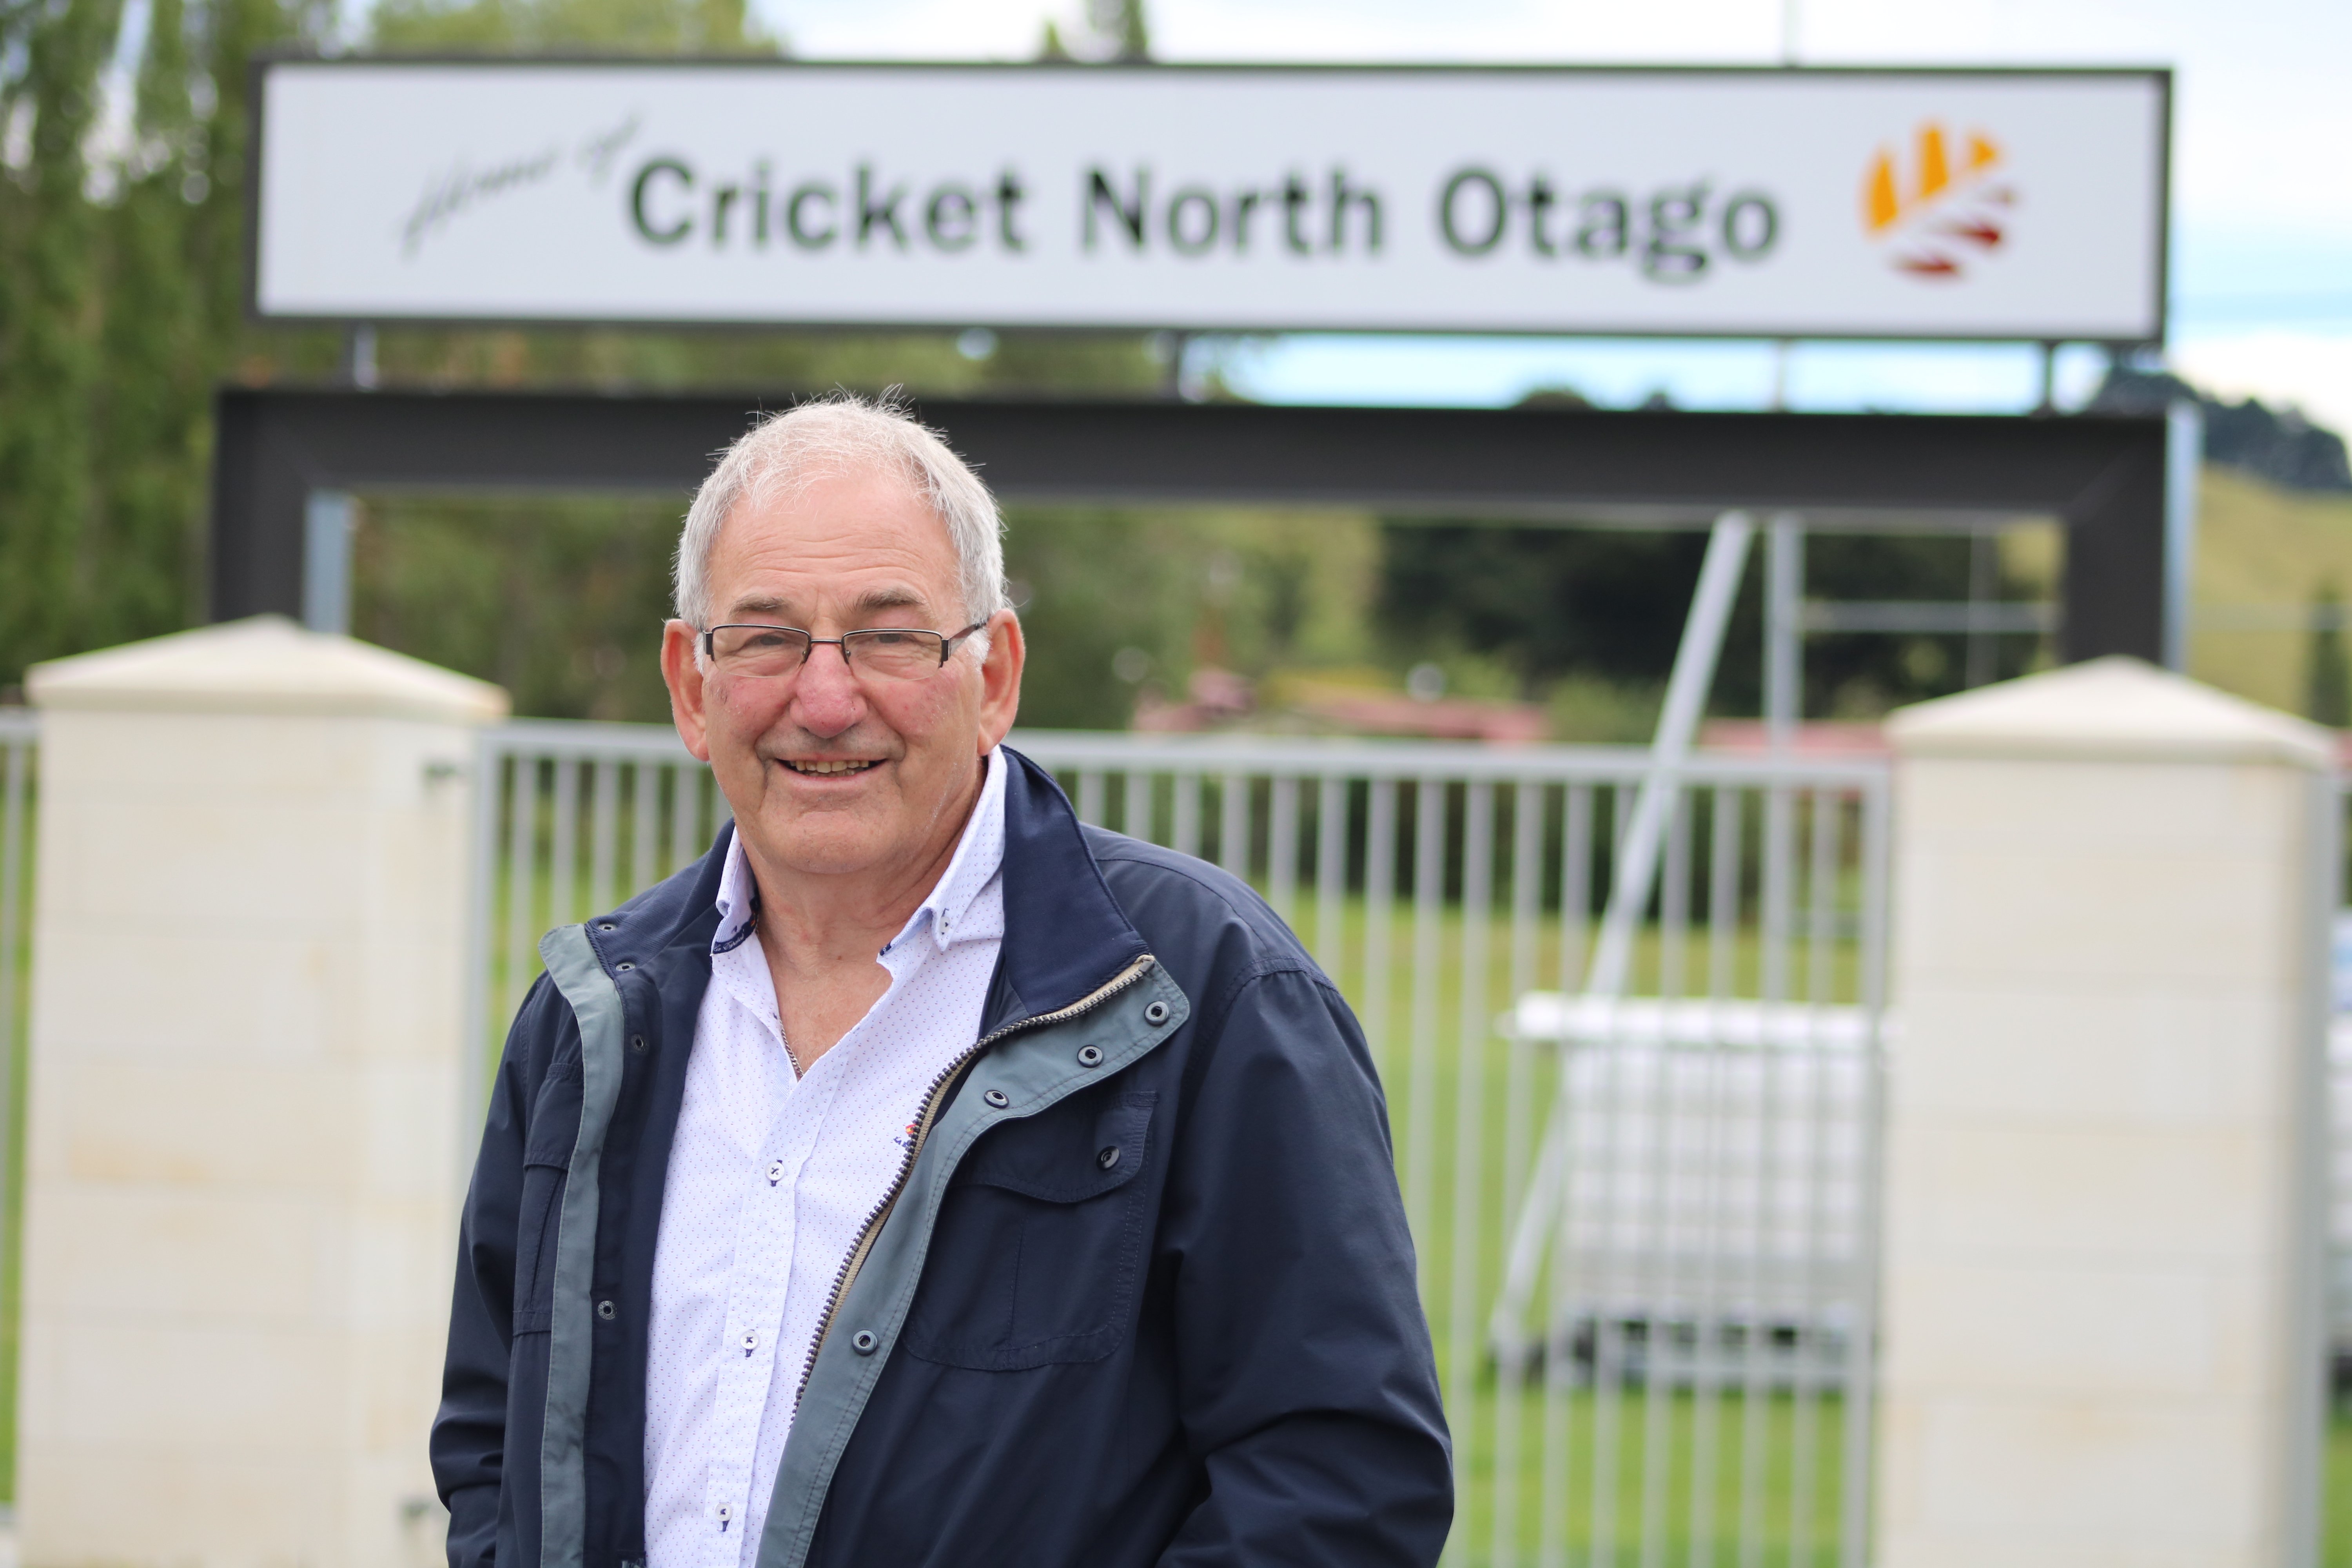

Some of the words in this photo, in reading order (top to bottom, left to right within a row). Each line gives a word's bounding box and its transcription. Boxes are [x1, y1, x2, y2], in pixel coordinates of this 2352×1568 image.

[625, 154, 1026, 255] Cricket
[1081, 165, 1385, 258] North
[1435, 165, 1782, 284] Otago
